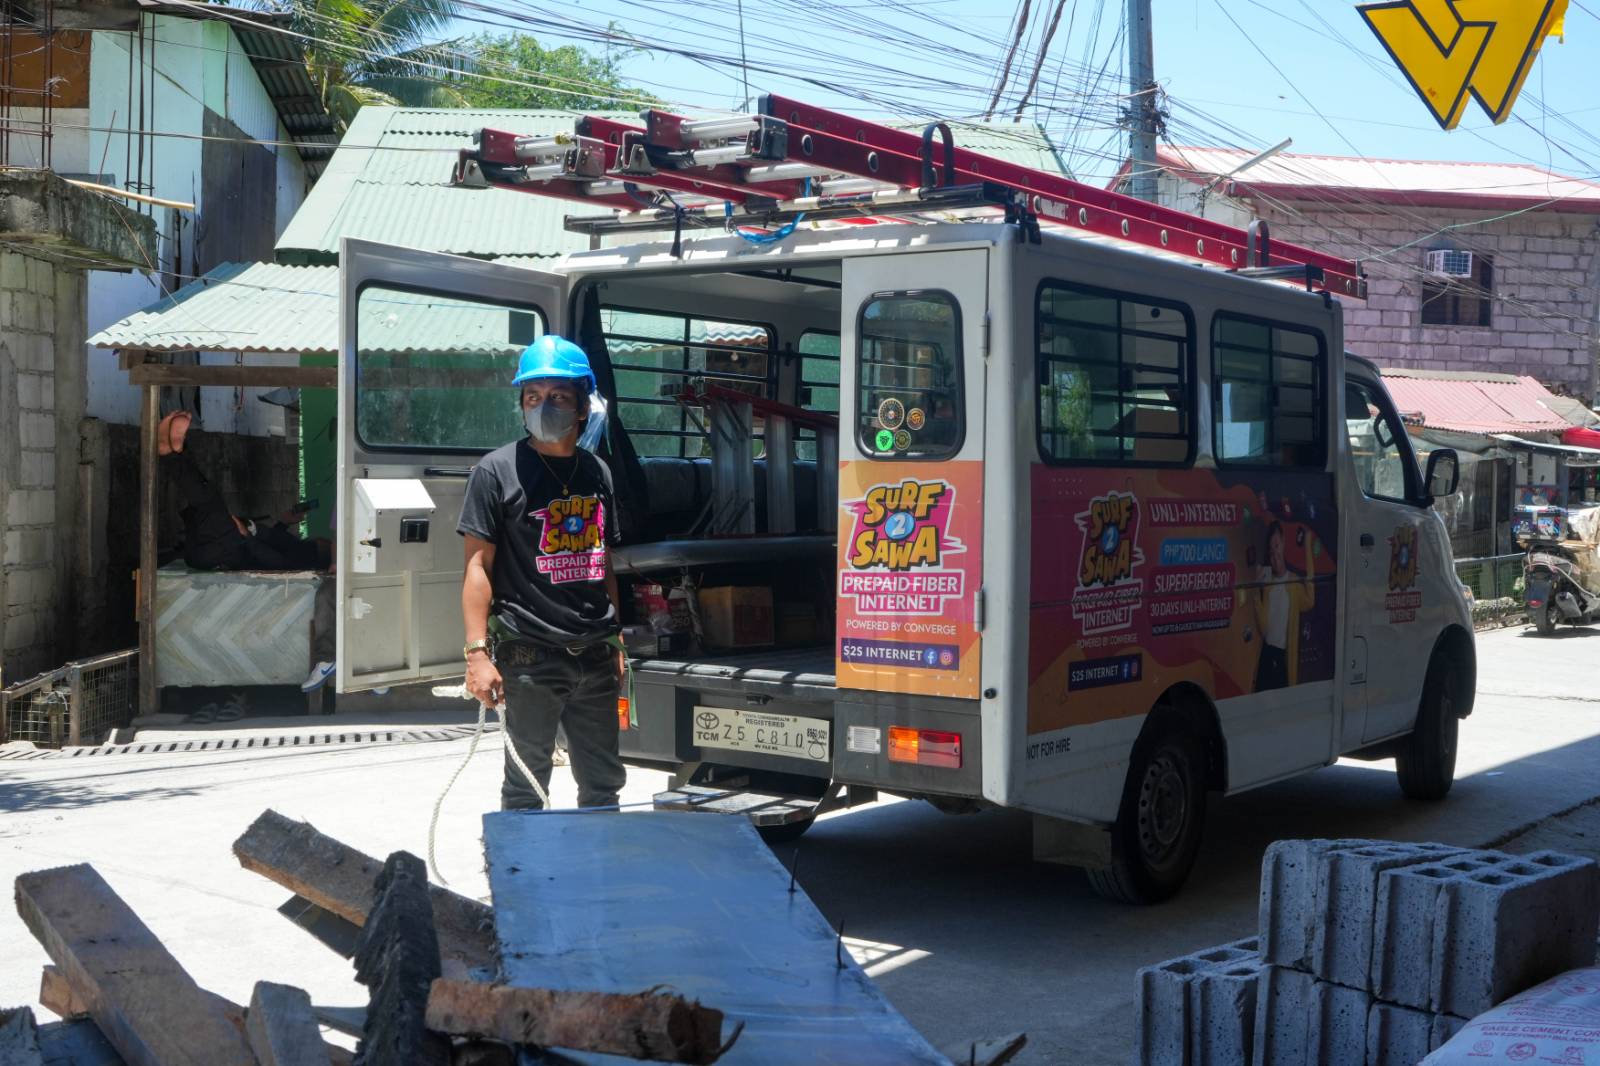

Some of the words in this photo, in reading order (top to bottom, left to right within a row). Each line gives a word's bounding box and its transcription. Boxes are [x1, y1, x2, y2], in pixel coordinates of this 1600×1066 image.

[548, 496, 600, 524] SURF
[863, 481, 945, 526] SURF
[1150, 503, 1237, 522] UNLI-INTERNET
[568, 516, 578, 532] 2
[891, 514, 906, 536] 2
[1091, 495, 1133, 541] SURF
[543, 524, 600, 554] SAWA
[852, 526, 940, 571] SAWA
[1105, 526, 1117, 552] 2
[540, 556, 588, 570] PREPAID
[1082, 540, 1131, 587] SAWA
[843, 576, 910, 592] PREPAID
[912, 577, 958, 592] FIBER
[860, 594, 938, 610] INTERNET
[1160, 601, 1180, 615] DAYS
[846, 619, 889, 631] POWERED
[890, 622, 901, 632] BY
[903, 623, 957, 635] CONVERGE
[1086, 607, 1129, 628] INTERNET
[843, 646, 863, 657] S2S
[866, 648, 923, 661] INTERNET
[1086, 665, 1119, 680] INTERNET
[745, 718, 785, 728] REGISTERED
[696, 731, 719, 742] TCM
[1026, 744, 1039, 760] NOT
[1040, 741, 1055, 760] FOR
[1056, 737, 1071, 753] HIRE
